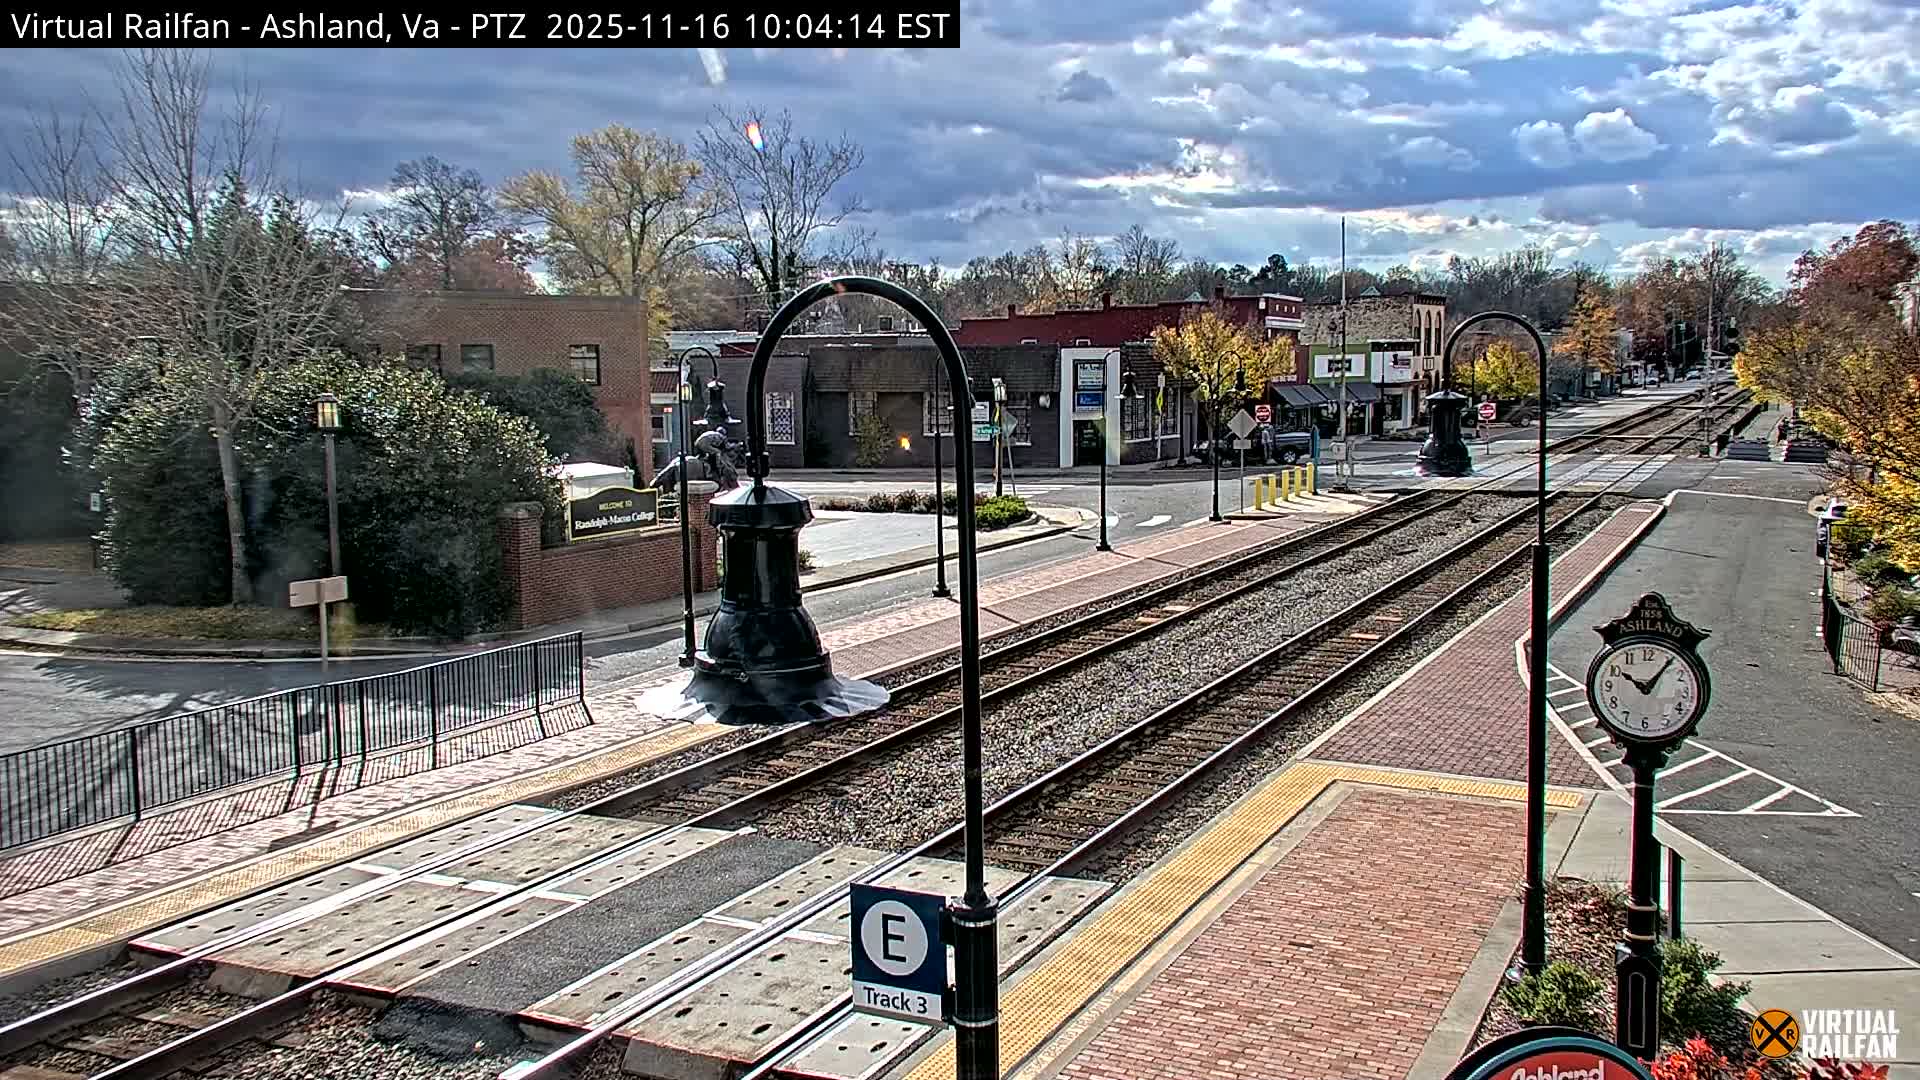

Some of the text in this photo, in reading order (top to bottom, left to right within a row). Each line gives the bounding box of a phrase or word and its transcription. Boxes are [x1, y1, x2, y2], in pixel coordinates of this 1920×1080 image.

[631, 511, 655, 521] College
[1620, 619, 1683, 638] ASHLAND
[1625, 652, 1634, 665] 11
[1643, 649, 1655, 661] 12
[1610, 664, 1621, 677] 10
[1605, 680, 1612, 692] 9
[1609, 696, 1618, 709] 8
[1675, 702, 1683, 715] 4
[1621, 711, 1630, 723] 7
[1641, 717, 1649, 729] 6
[882, 913, 907, 963] E
[863, 986, 928, 1014] Track 3
